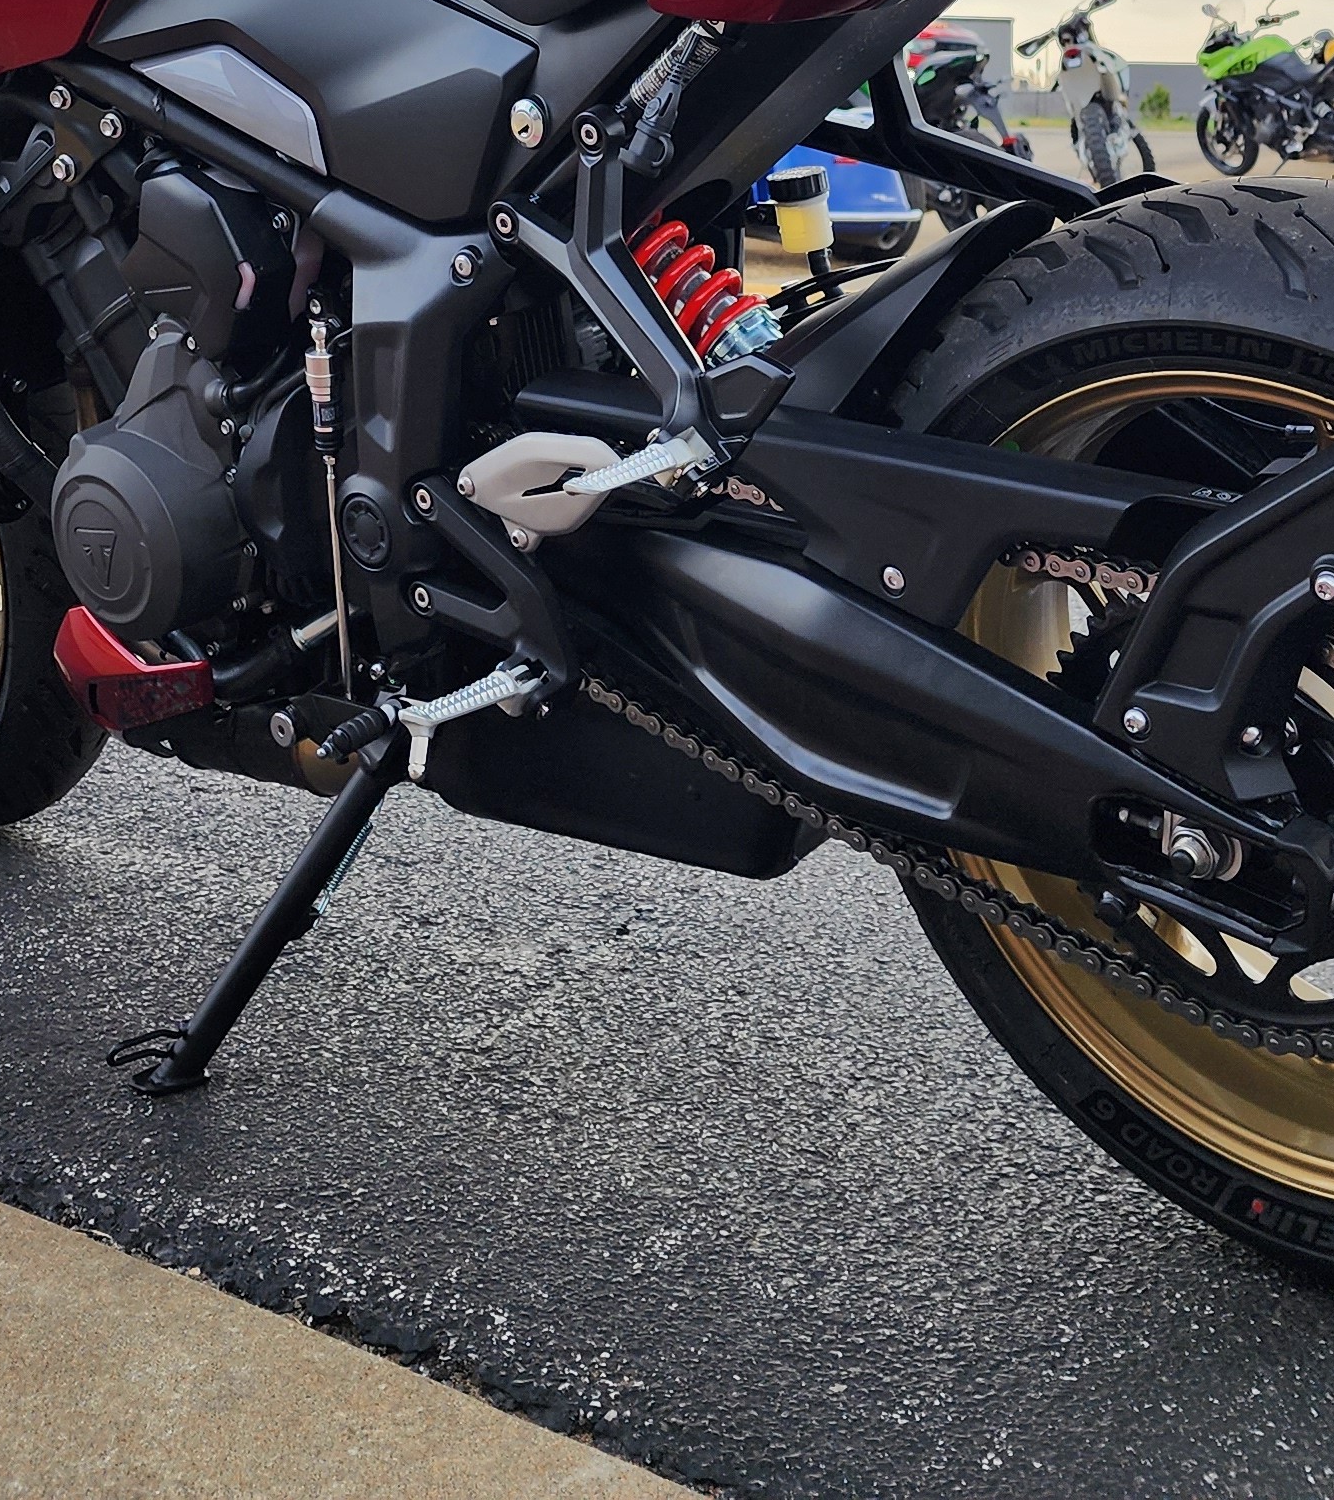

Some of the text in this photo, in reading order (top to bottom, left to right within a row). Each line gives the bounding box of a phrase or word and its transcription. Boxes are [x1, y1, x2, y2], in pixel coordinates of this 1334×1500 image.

[1074, 330, 1272, 365] MICHELIN
[1091, 1097, 1117, 1123] 6
[1122, 1123, 1217, 1195] ROAD
